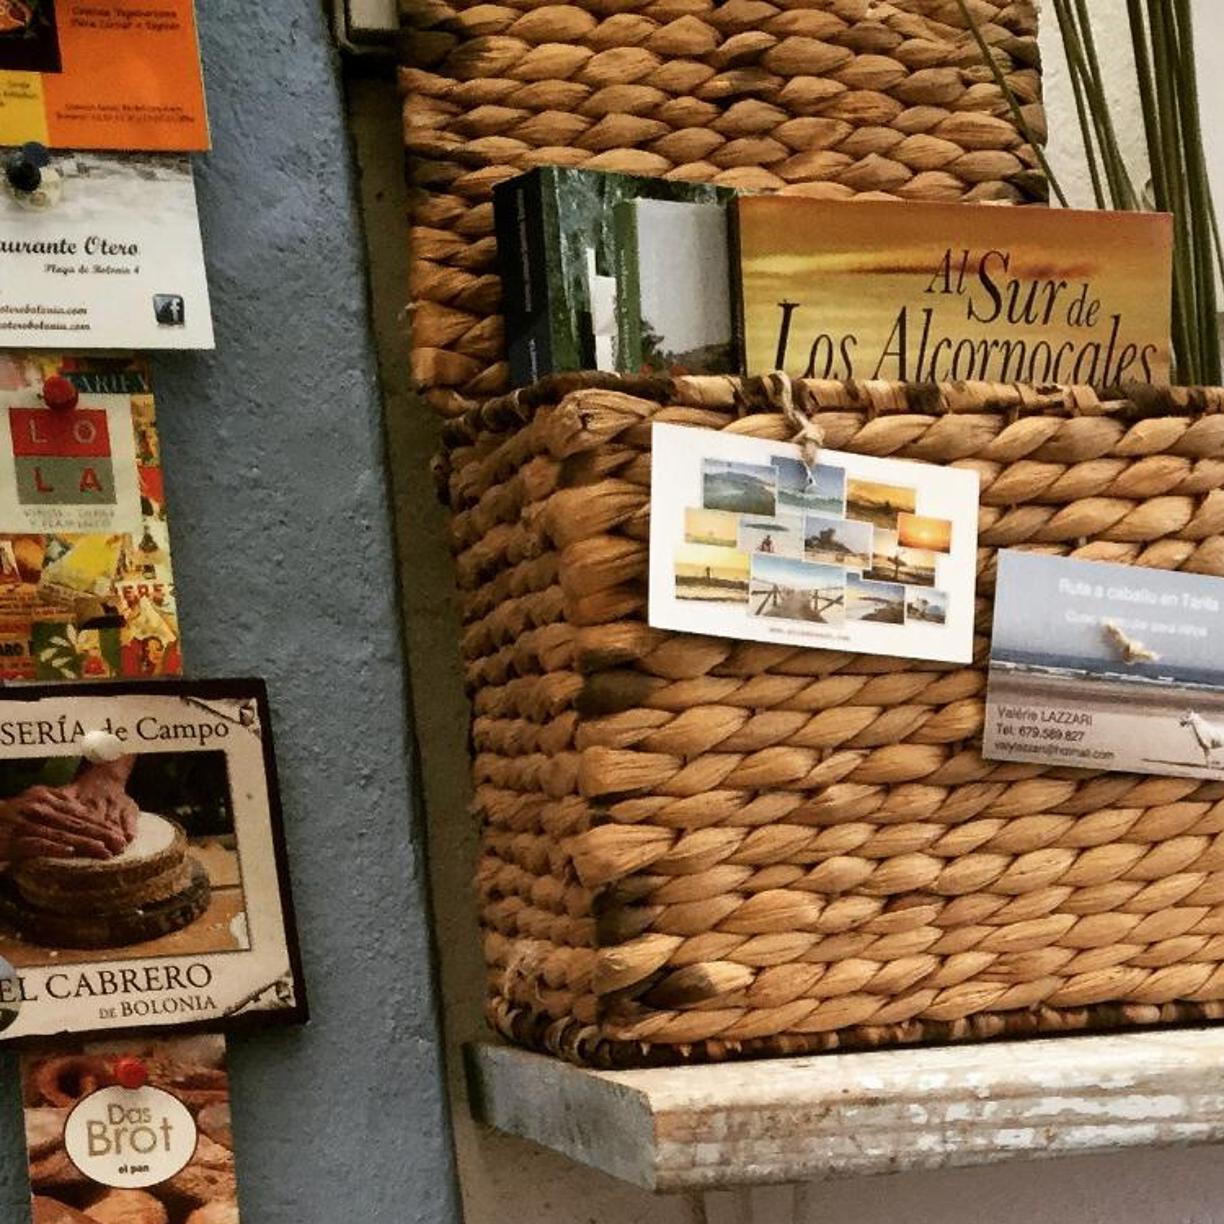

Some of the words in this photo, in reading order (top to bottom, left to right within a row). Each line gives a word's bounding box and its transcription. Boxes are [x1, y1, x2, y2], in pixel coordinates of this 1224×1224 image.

[84, 235, 139, 256] Otero
[925, 246, 969, 296] Al
[966, 250, 1066, 328] Sur
[1066, 282, 1102, 328] de
[772, 300, 858, 382] Los
[874, 305, 1158, 386] Alcornocales
[997, 705, 1038, 722] Valérie
[1041, 710, 1093, 726] LAZZARI
[136, 716, 230, 747] Campo
[0, 977, 39, 1005] EL
[45, 963, 213, 1001] CABRERO
[99, 1006, 118, 1019] DE
[120, 994, 218, 1019] BOLONIA
[107, 1102, 153, 1125] Das
[86, 1116, 174, 1157] Brot
[118, 1164, 129, 1174] el
[131, 1164, 150, 1176] pan
